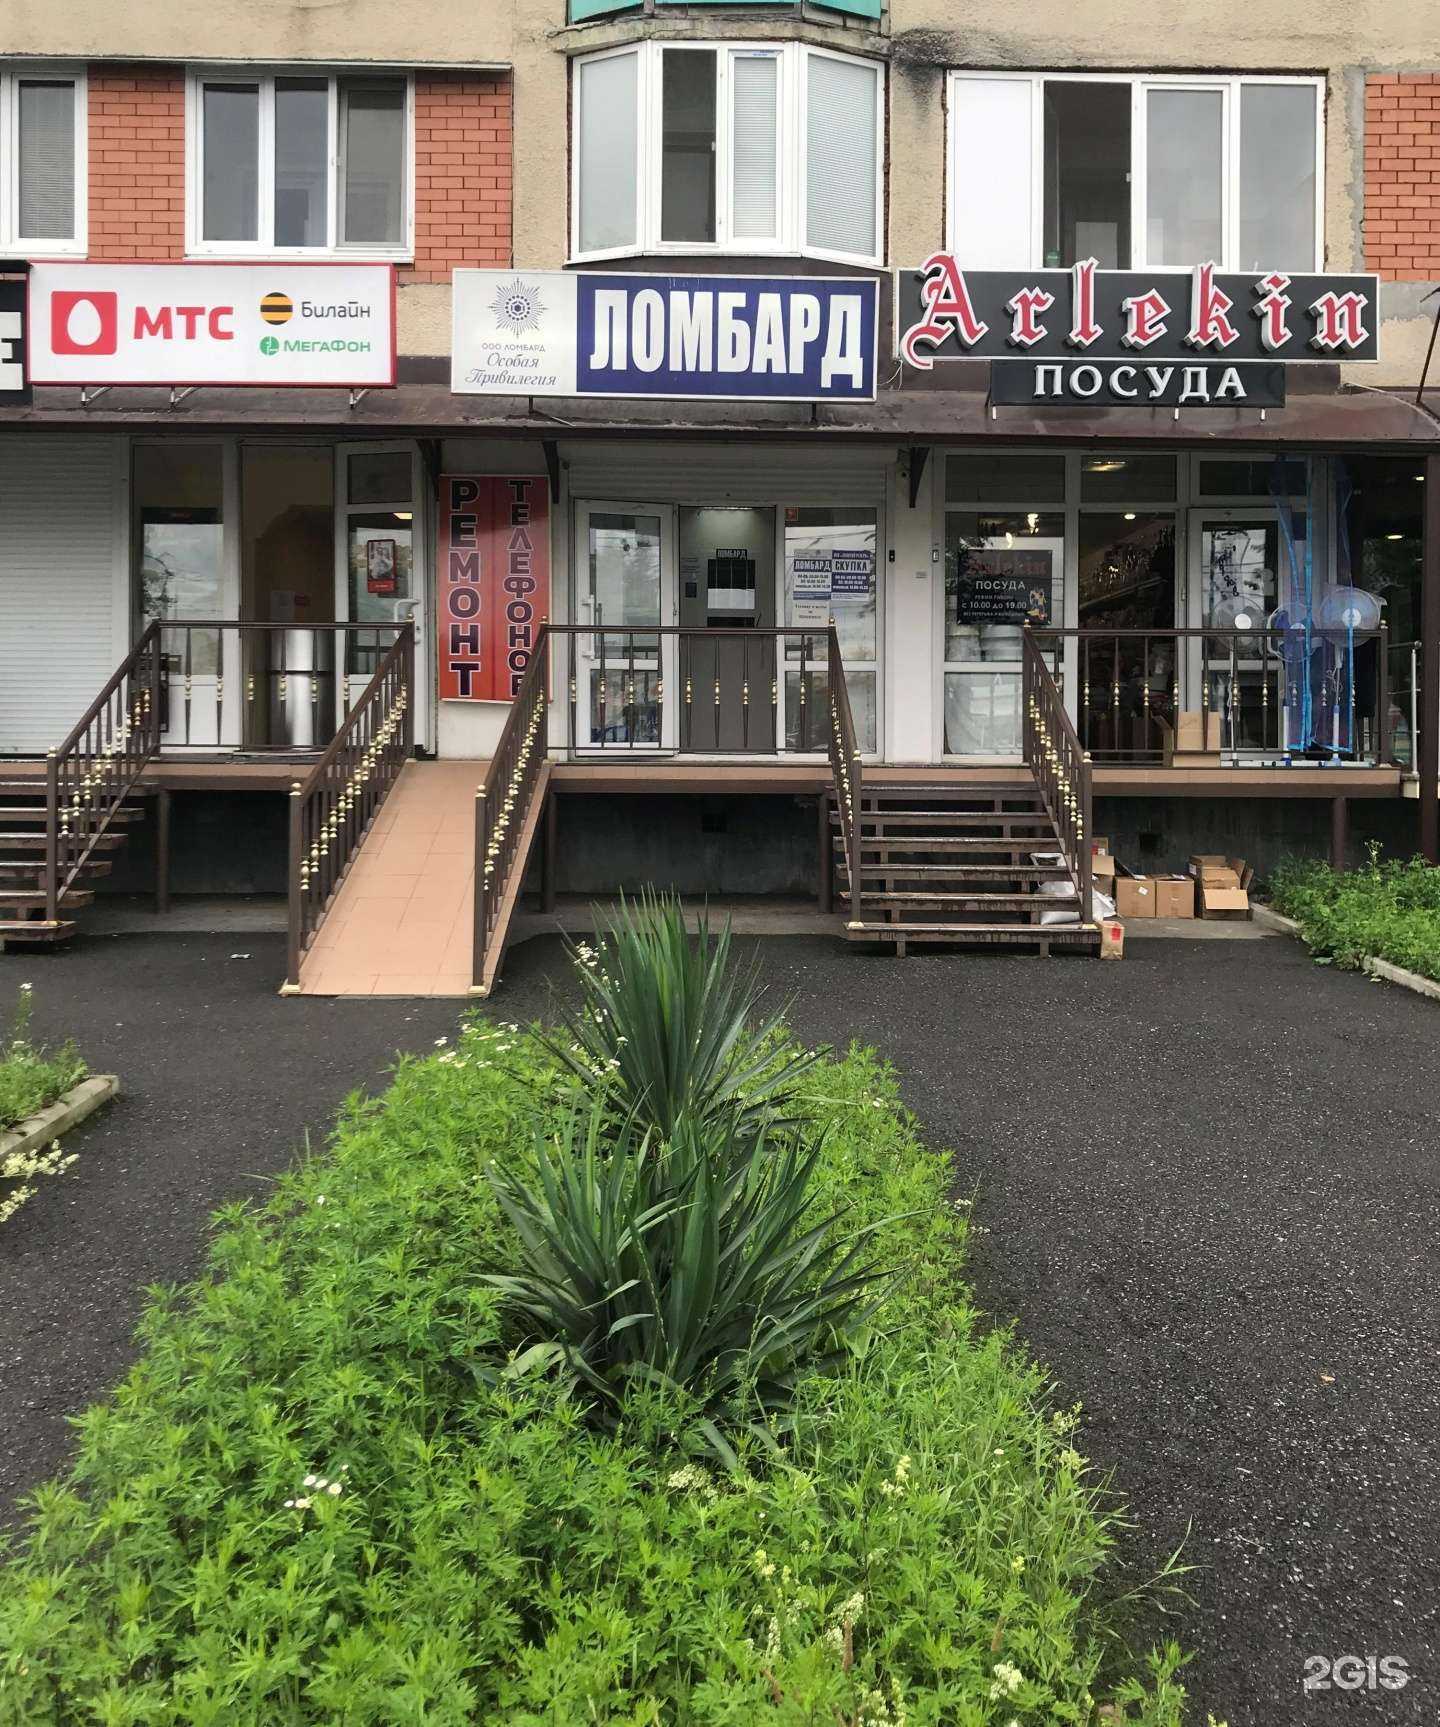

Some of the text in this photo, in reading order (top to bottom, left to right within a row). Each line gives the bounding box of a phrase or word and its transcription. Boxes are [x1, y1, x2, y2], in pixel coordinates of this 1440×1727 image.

[301, 300, 371, 319] Билайн
[900, 251, 1369, 369] Arlekin
[133, 306, 234, 340] МТС
[481, 342, 546, 353] ООО ЛОМБАРД
[589, 288, 864, 389] ЛОМБАРД
[487, 352, 539, 368] Особая
[465, 368, 559, 387] Привилегия
[1034, 364, 1247, 402] ПОСУДА
[795, 560, 831, 571] ЛОМБАРД
[835, 560, 867, 571] СКУПКА
[448, 478, 481, 697] РЕМОНТ
[975, 580, 1026, 591] ПОСУДА
[970, 601, 991, 609] 10.00
[1006, 601, 1027, 609] 19.00
